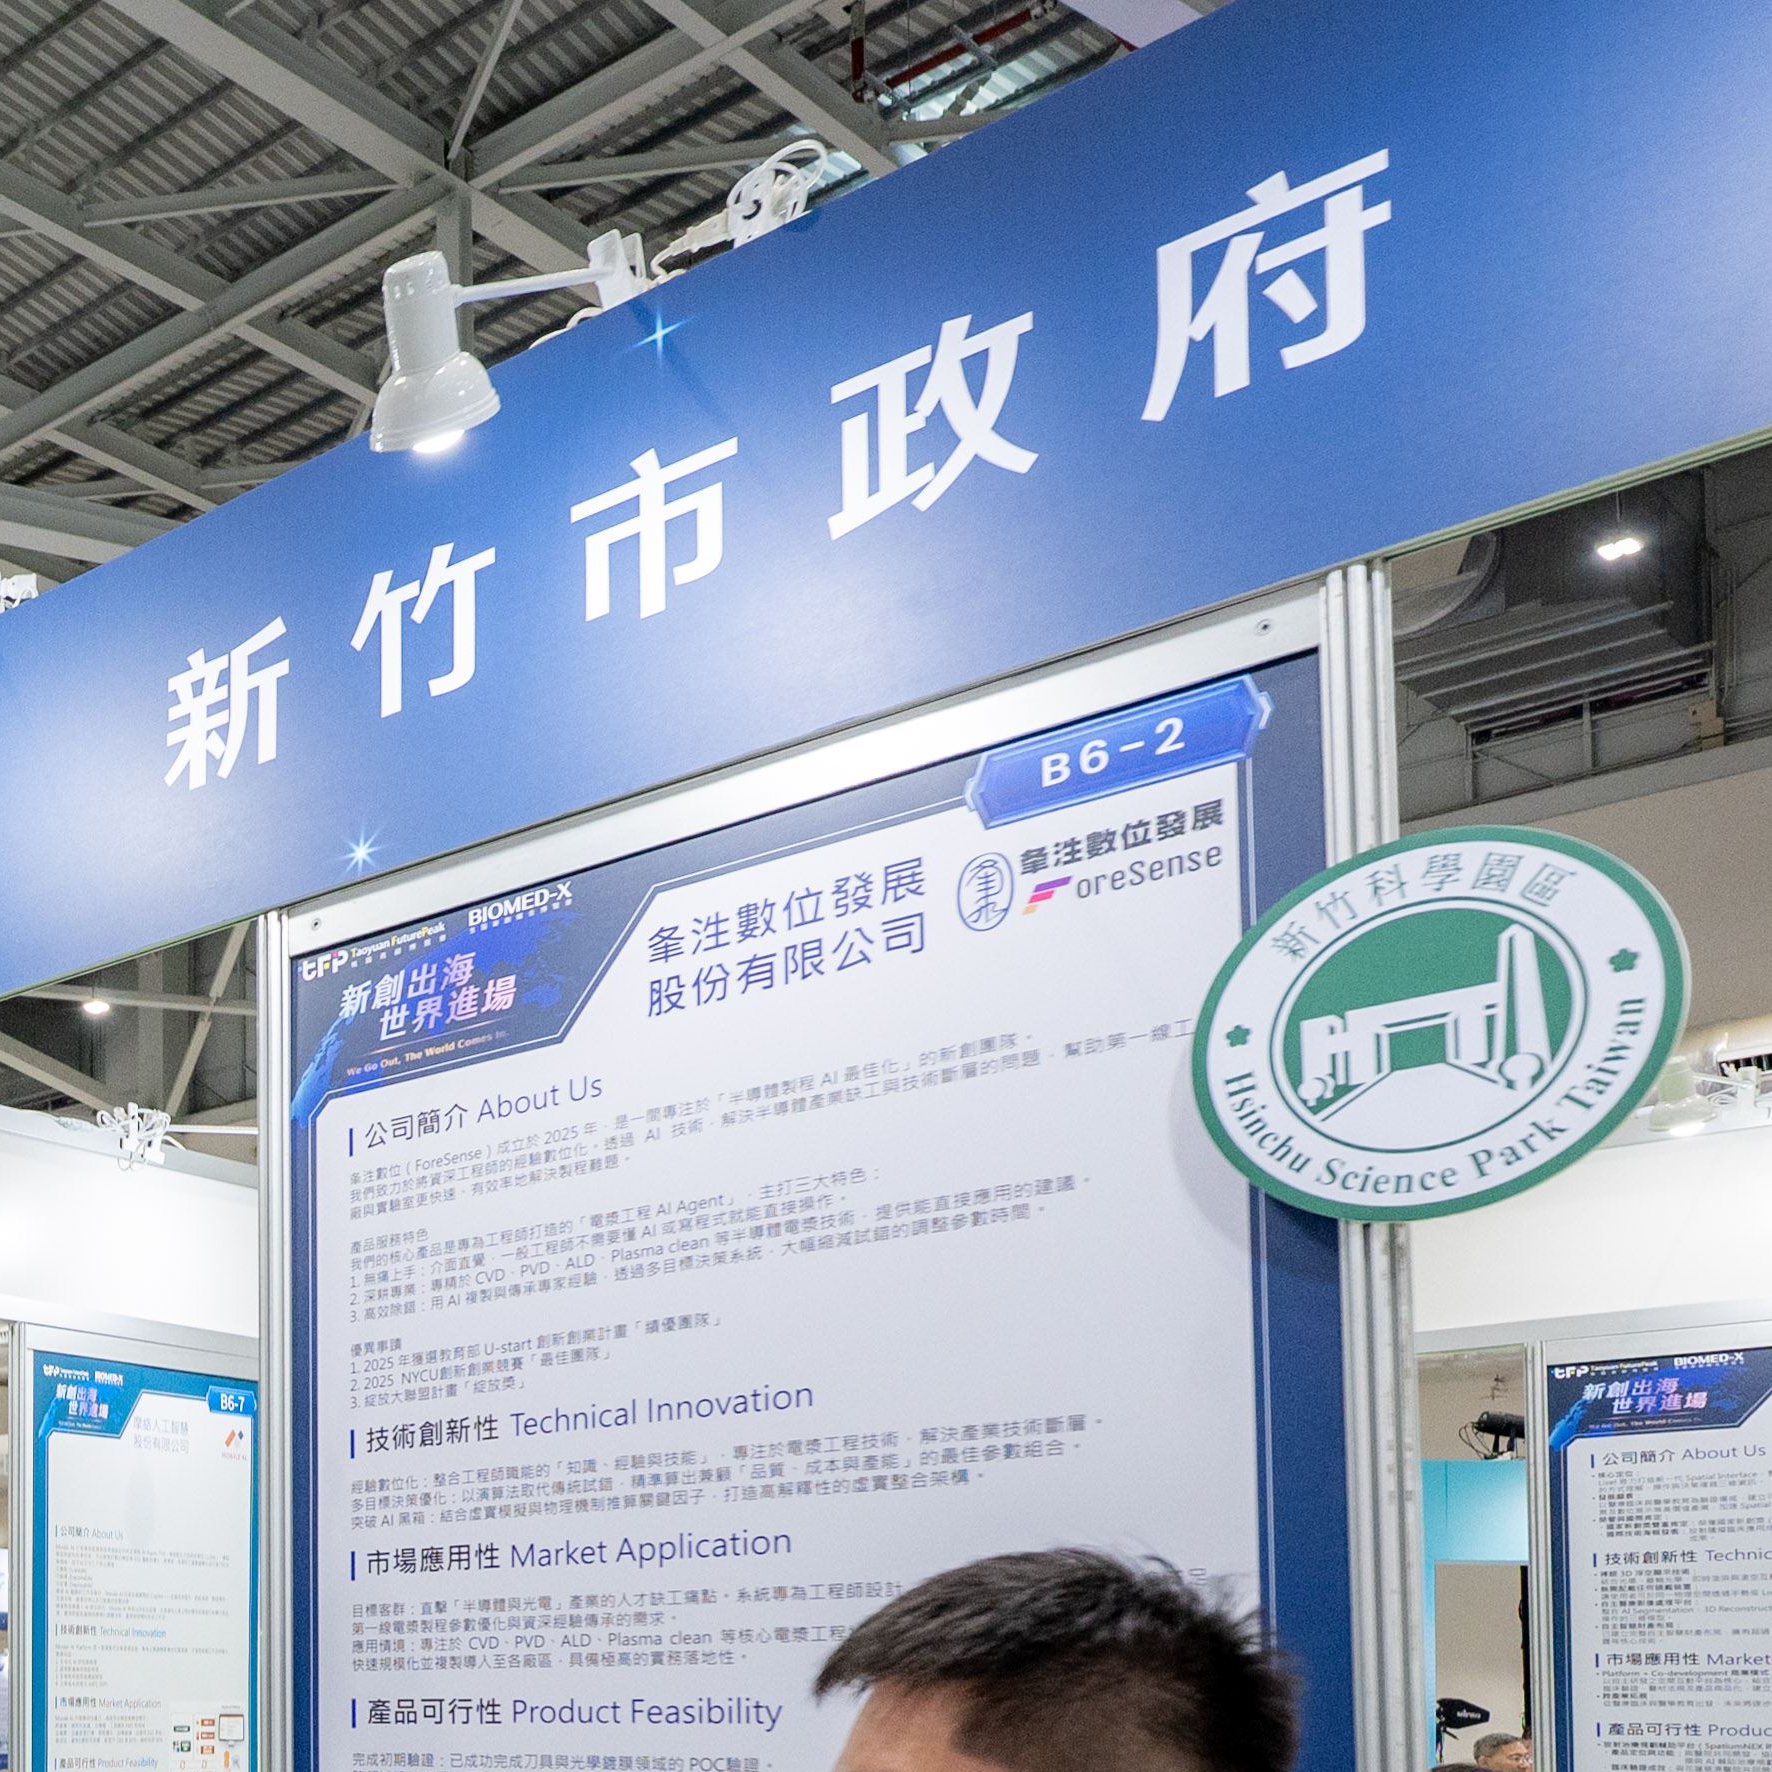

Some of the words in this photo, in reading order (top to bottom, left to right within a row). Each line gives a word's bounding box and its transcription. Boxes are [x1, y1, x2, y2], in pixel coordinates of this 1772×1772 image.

[164, 146, 1393, 792] 新竹市政府
[1040, 717, 1187, 788] B6-2
[468, 881, 573, 928] BIOMED-X
[1270, 850, 1579, 963] 新竹科學園區
[351, 938, 391, 960] Taoyuan
[391, 921, 446, 947] FuturePeak
[647, 912, 926, 1018] 股份有限公司
[338, 951, 477, 1019] 新創出海
[379, 974, 517, 1042] 世界進場
[363, 1061, 379, 1075] Go
[380, 1055, 402, 1070] Out,
[404, 1049, 424, 1063] The
[424, 1042, 456, 1058] World
[456, 1033, 493, 1049] Comes
[1222, 1070, 1312, 1175] Hsinchu
[1315, 1156, 1459, 1196] Science
[1468, 1120, 1569, 1179] Park
[1556, 995, 1646, 1125] Taiwan
[364, 1100, 468, 1151] 公司簡介
[477, 1080, 560, 1125] About
[568, 1071, 602, 1105] Us
[544, 1124, 579, 1147] 2025
[820, 1071, 839, 1092] AI
[645, 1125, 660, 1145] AI
[656, 1200, 673, 1219] AI
[642, 1221, 657, 1240] AI
[667, 1232, 709, 1256] clean
[447, 1290, 461, 1308] AI
[363, 1354, 394, 1373] 2025
[484, 1336, 532, 1358] U-start
[1673, 1352, 1745, 1367] BIOMED-X
[363, 1372, 394, 1391] 2025
[1581, 1377, 1680, 1400] 新創出海
[220, 1393, 246, 1412] B6-7
[1611, 1391, 1708, 1415] 世界進場
[365, 1413, 499, 1455] 技術創新性
[510, 1397, 637, 1441] Technical
[646, 1378, 813, 1427] Innovation
[133, 1436, 190, 1455] 股份有限公司
[1602, 1449, 1676, 1466] 公司簡介
[1681, 1447, 1739, 1461] About
[1743, 1444, 1767, 1457] Us
[60, 1524, 90, 1538] 公司簡介
[91, 1526, 114, 1539] About
[114, 1530, 124, 1541] Us
[350, 1513, 377, 1531] 突破
[380, 1512, 394, 1528] AI
[366, 1540, 501, 1579] 市場應用性
[510, 1537, 609, 1571] Market
[616, 1524, 792, 1573] Application
[1604, 1550, 1698, 1566] 技術創新性
[60, 1623, 97, 1637] 技術創新性
[99, 1624, 131, 1637] Technical
[131, 1627, 167, 1639] Innovation
[669, 1627, 712, 1646] clean
[1606, 1651, 1700, 1666] 市場應用性
[1706, 1653, 1772, 1666] Market
[59, 1695, 97, 1709] 市場應用性
[98, 1697, 123, 1709] Market
[124, 1698, 162, 1711] Application
[366, 1695, 503, 1726] 產品可行性
[512, 1697, 623, 1725] Product
[630, 1695, 782, 1733] Feasibility
[1607, 1722, 1703, 1737] 產品可行性
[59, 1757, 97, 1770] 產品可行性
[97, 1757, 124, 1770] Product
[124, 1757, 159, 1771] Feasibility
